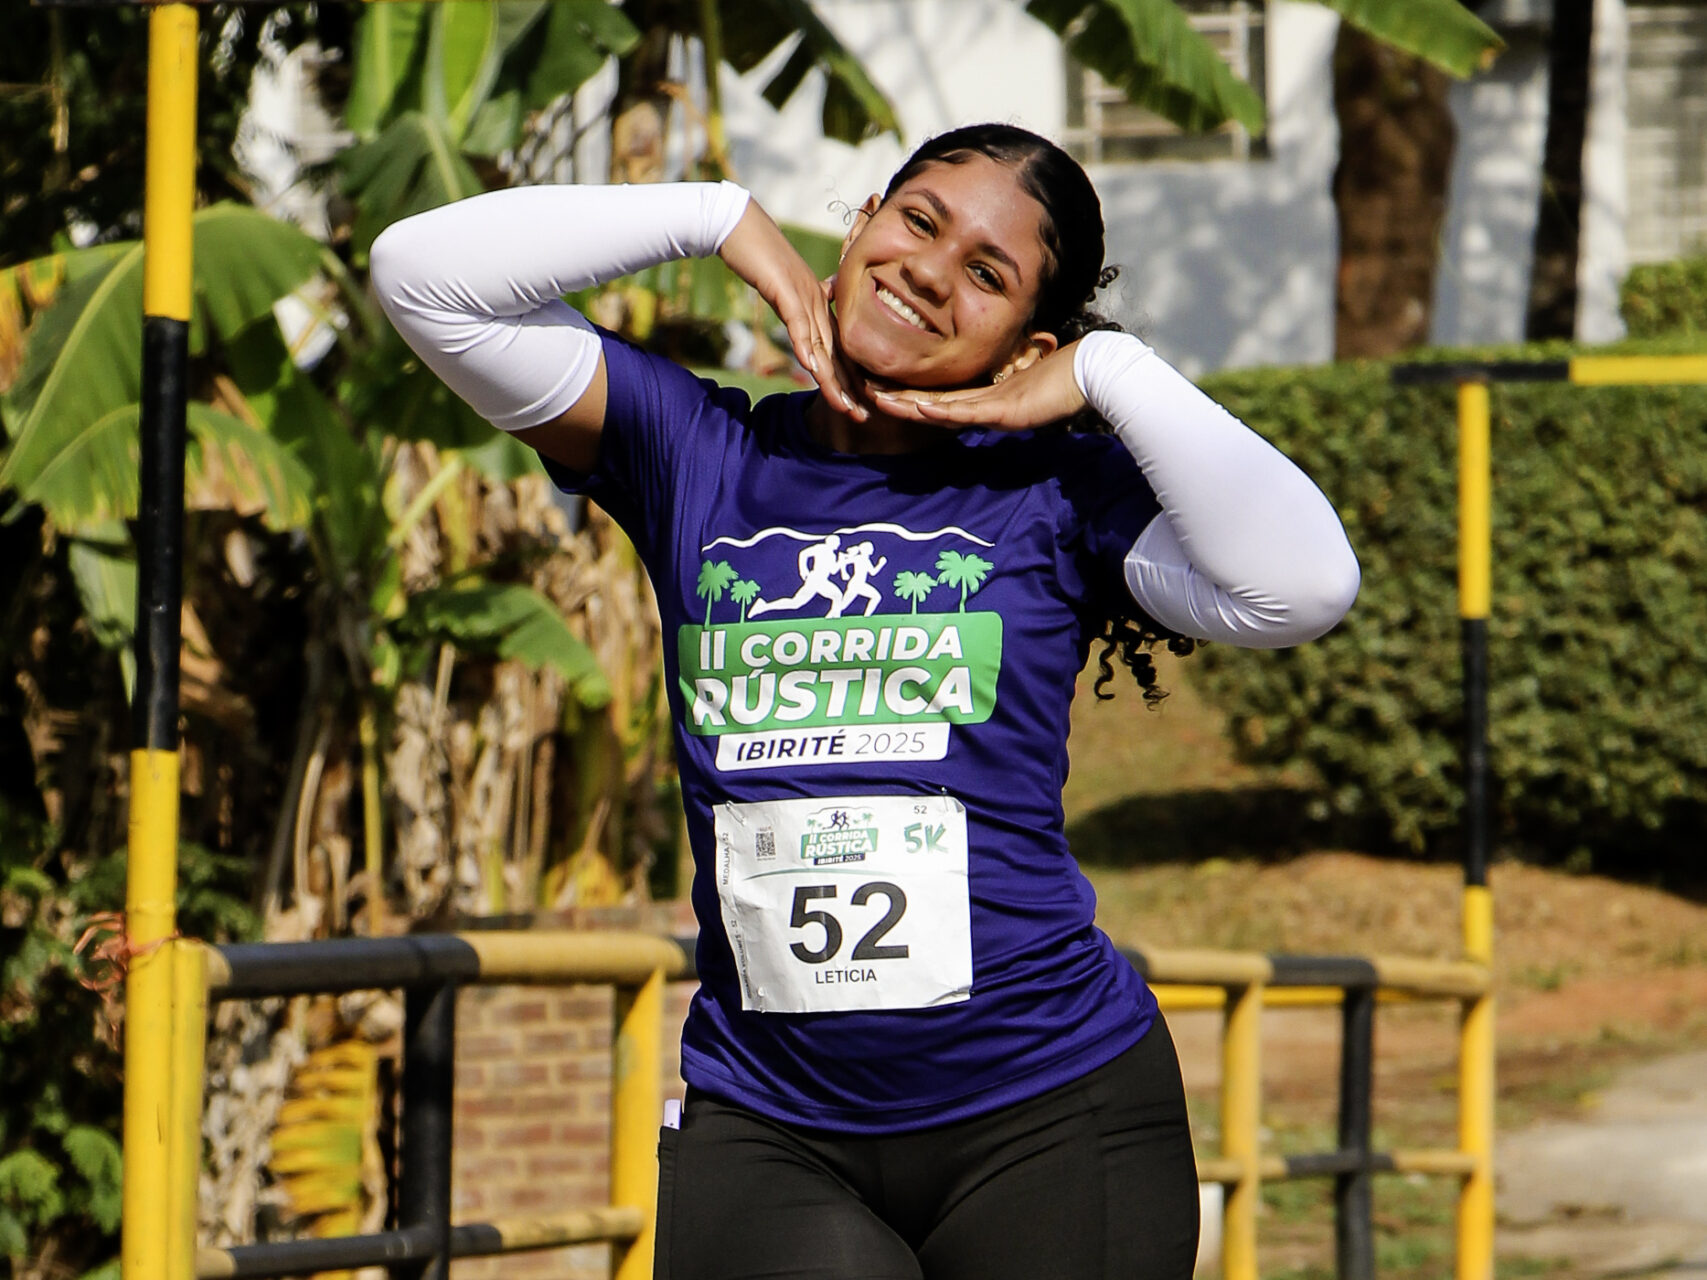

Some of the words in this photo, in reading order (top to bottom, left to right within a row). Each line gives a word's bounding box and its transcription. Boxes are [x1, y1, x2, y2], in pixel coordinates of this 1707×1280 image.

[700, 630, 726, 670] II
[740, 626, 963, 667] CORRIDA
[692, 667, 975, 725] RÚSTICA
[736, 729, 847, 762] IBIRITÉ
[855, 731, 926, 755] 2025
[914, 804, 928, 814] 52
[808, 833, 817, 844] II
[820, 830, 869, 844] CORRIDA
[904, 822, 948, 854] 5K
[790, 882, 909, 964] 52
[815, 966, 877, 984] LETÍCIA
